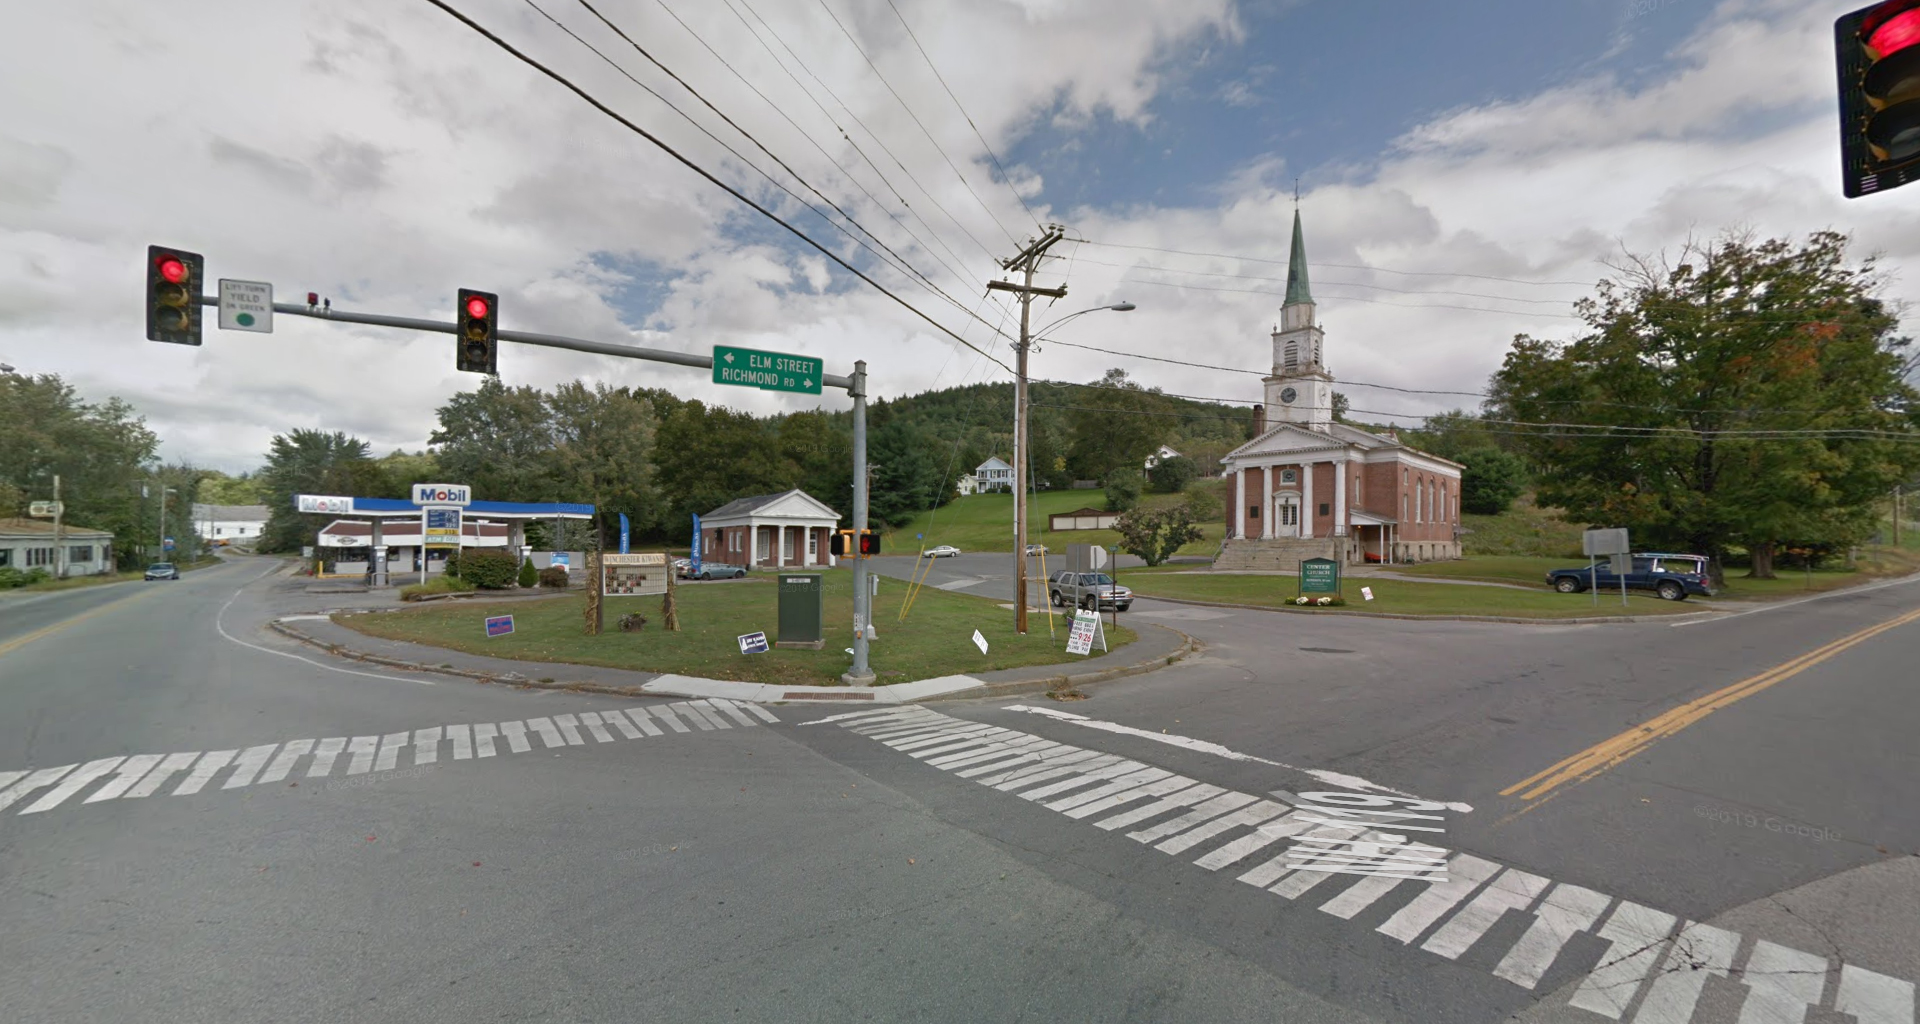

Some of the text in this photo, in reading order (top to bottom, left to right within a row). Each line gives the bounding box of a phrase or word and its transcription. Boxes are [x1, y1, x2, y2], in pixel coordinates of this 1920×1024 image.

[230, 292, 260, 303] YIELD
[749, 354, 815, 375] ELM STREET
[722, 367, 795, 388] RICHMOND RD
[420, 488, 466, 502] Mobil
[302, 497, 349, 512] Mobil
[642, 554, 665, 562] KIWANIS
